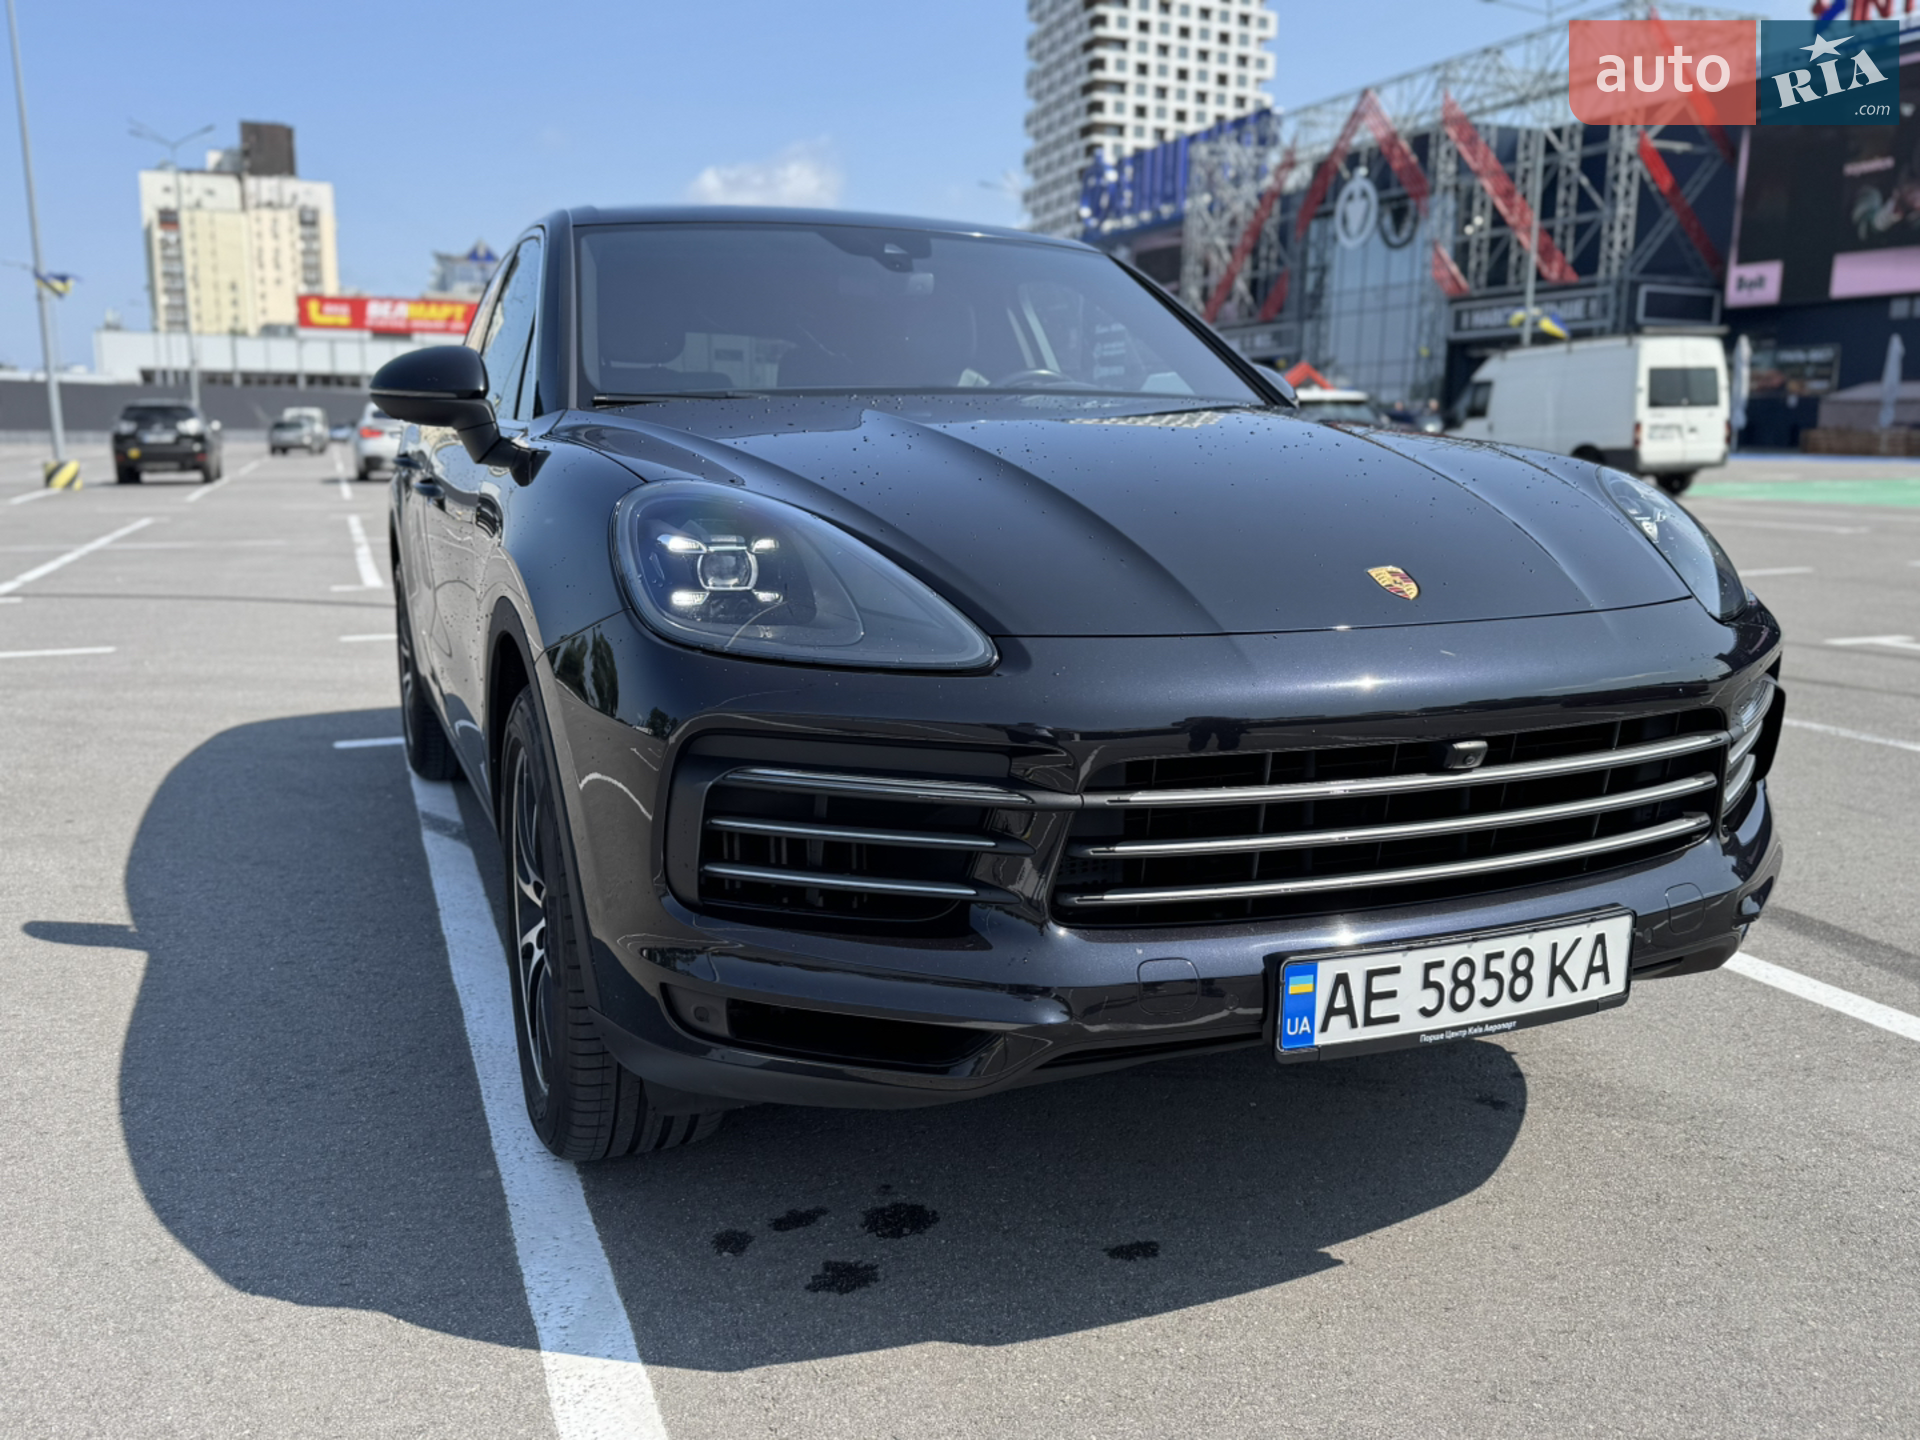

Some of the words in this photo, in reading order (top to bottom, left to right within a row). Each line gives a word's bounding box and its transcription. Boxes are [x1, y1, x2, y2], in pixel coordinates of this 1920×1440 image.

[1319, 965, 1401, 1033] AE
[1418, 947, 1534, 1018] 5858
[1548, 932, 1610, 997] KA
[1286, 1016, 1312, 1035] UA
[1420, 1033, 1444, 1043] Порше
[1445, 1029, 1467, 1039] Центр
[1484, 1020, 1517, 1033] Аеропорт
